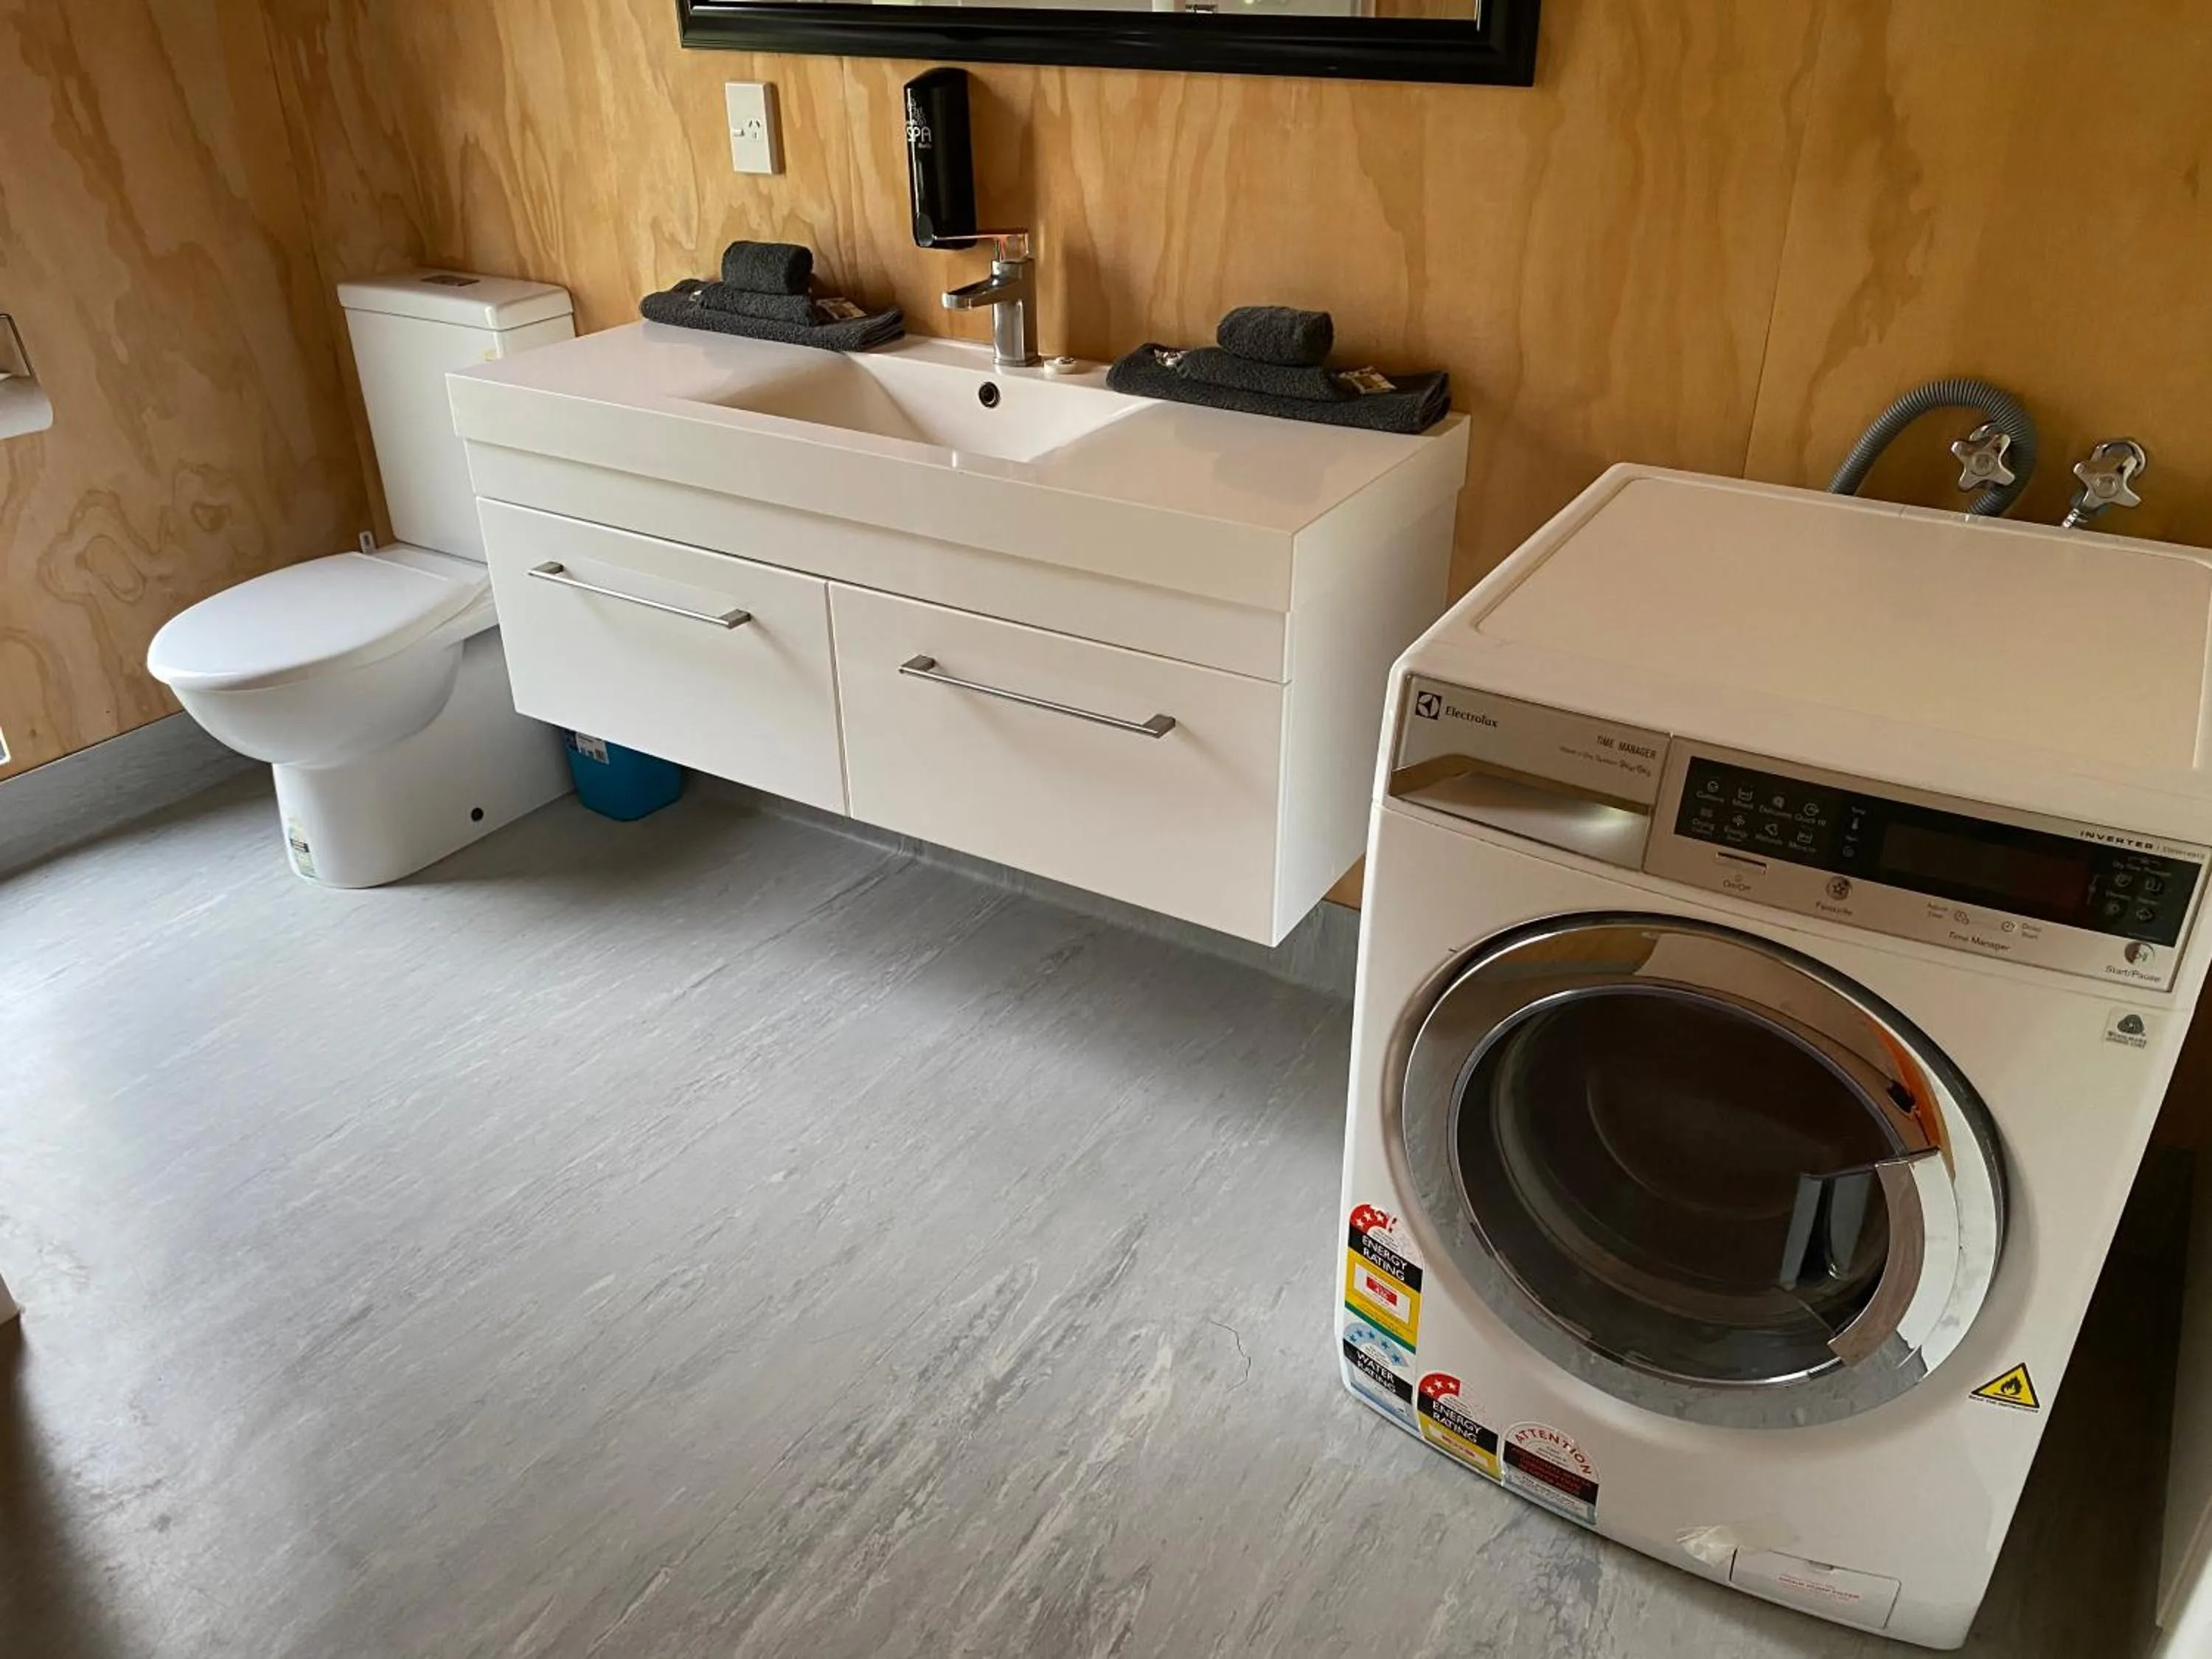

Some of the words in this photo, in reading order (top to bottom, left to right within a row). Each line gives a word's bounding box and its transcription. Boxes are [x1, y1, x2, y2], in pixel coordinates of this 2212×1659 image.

[1445, 705, 1499, 728] Electrolux
[1618, 742, 1657, 760] MANAGER
[2080, 830, 2154, 850] INVERTER
[1362, 1234, 1408, 1270] ENERGY
[1363, 1248, 1405, 1281] RATING
[1357, 1350, 1395, 1384] WATER
[1357, 1360, 1397, 1394] RATING
[1433, 1400, 1482, 1434] ENERGY
[1433, 1411, 1478, 1444] RATING
[1514, 1428, 1592, 1475] ATTENTION
